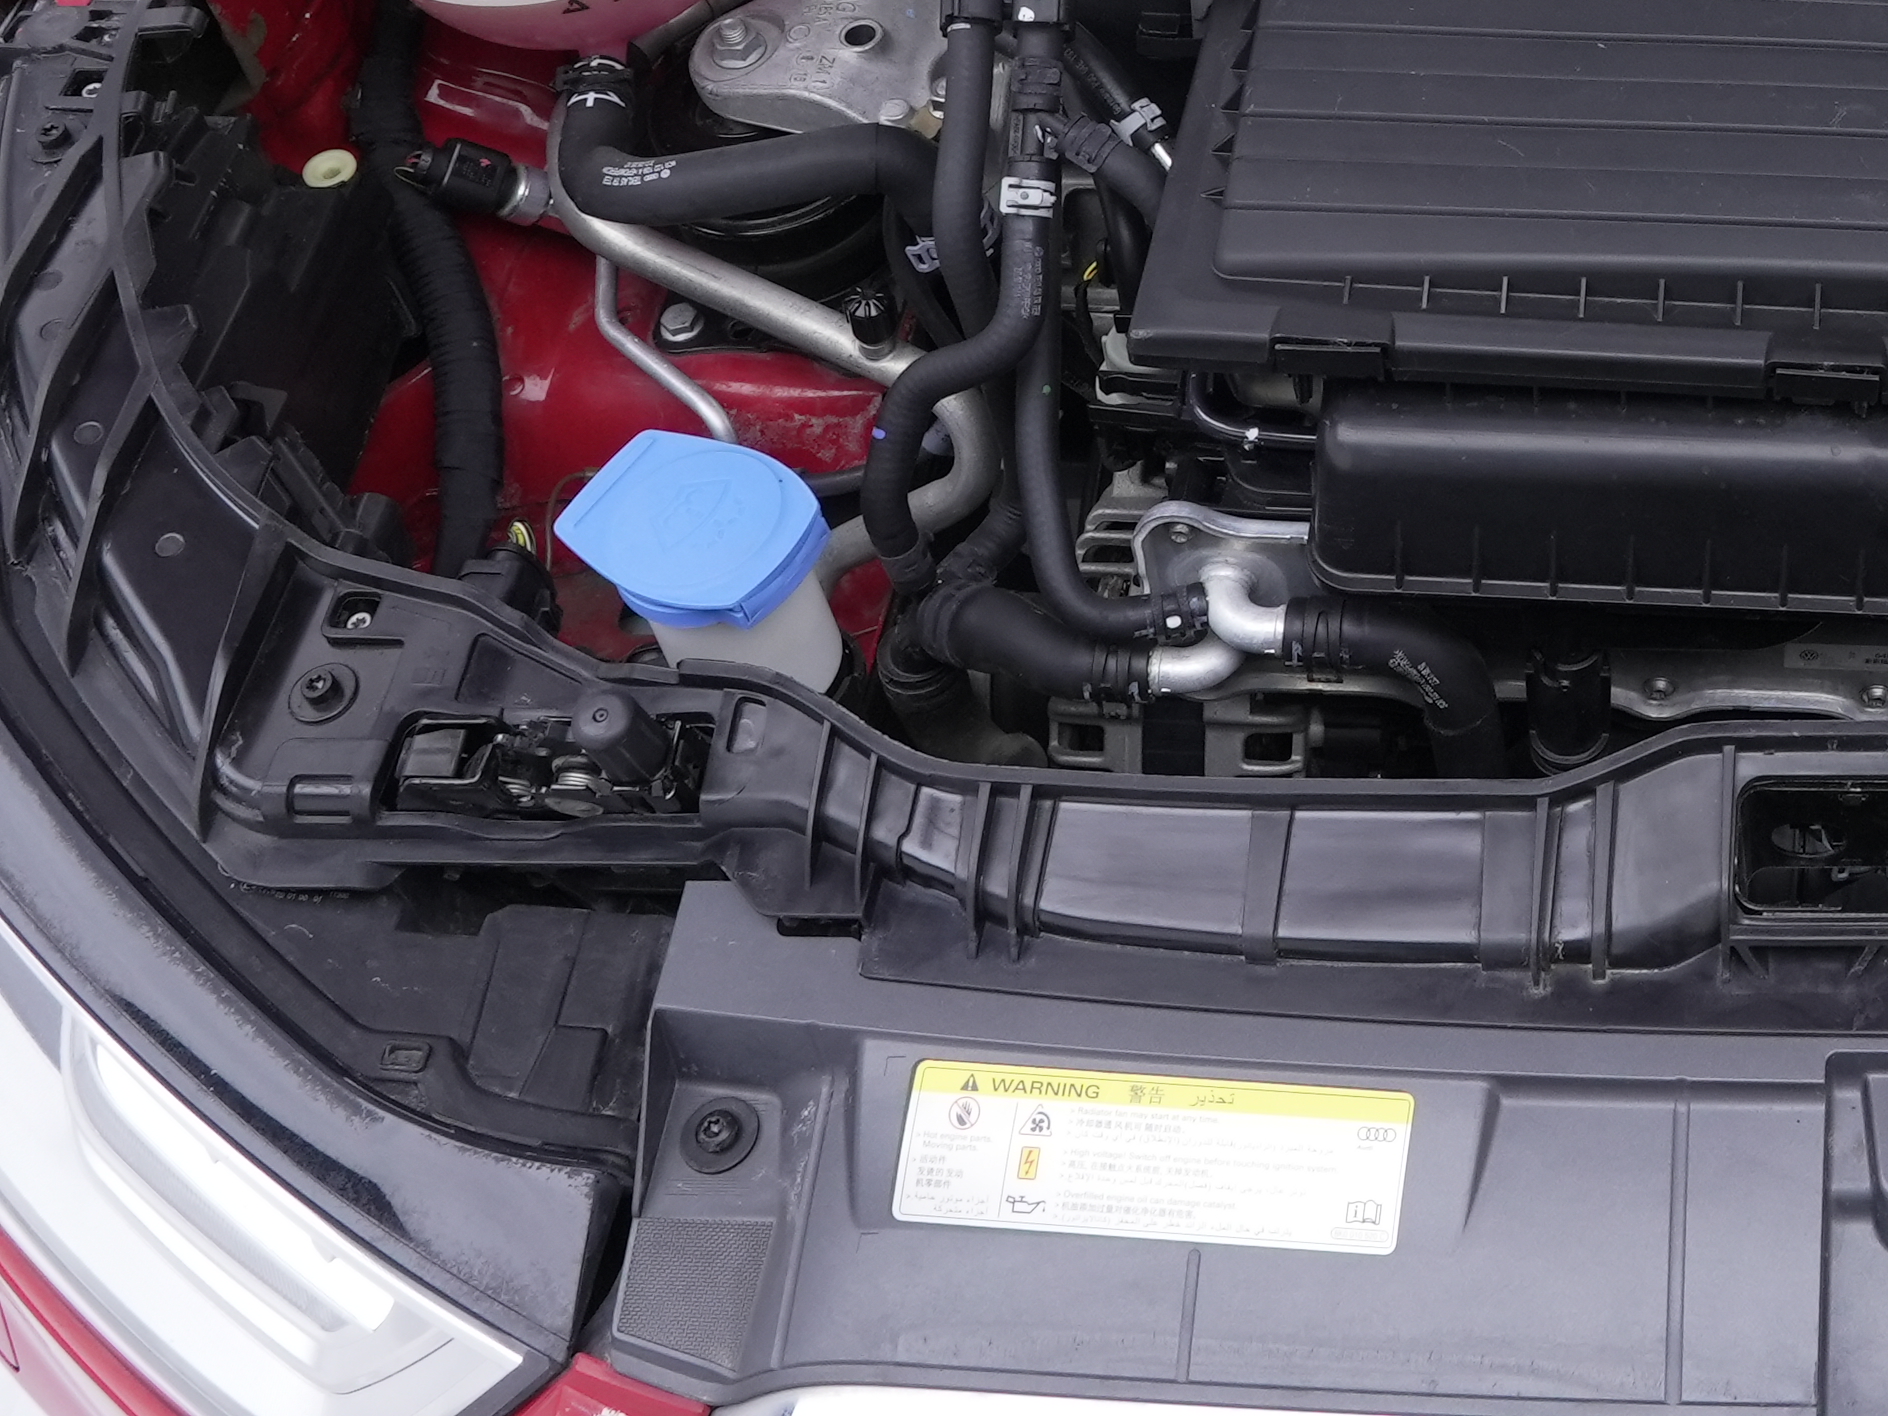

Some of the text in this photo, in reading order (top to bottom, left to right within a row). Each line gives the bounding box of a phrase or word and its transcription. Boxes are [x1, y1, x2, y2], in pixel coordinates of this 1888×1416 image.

[991, 1077, 1101, 1100] WARNING
[1128, 1084, 1166, 1105] 警告
[1188, 1089, 1235, 1108] تحذير
[1077, 1106, 1220, 1124] Radiator fan may start at any time.
[922, 1140, 979, 1153] Moving parts.
[923, 1130, 993, 1144] Hot engine parts.
[1070, 1148, 1339, 1175] High voltage! Switch off engine before touching ignition system.
[1063, 1189, 1237, 1210] Overfilled engine oil can damage catalyst.
